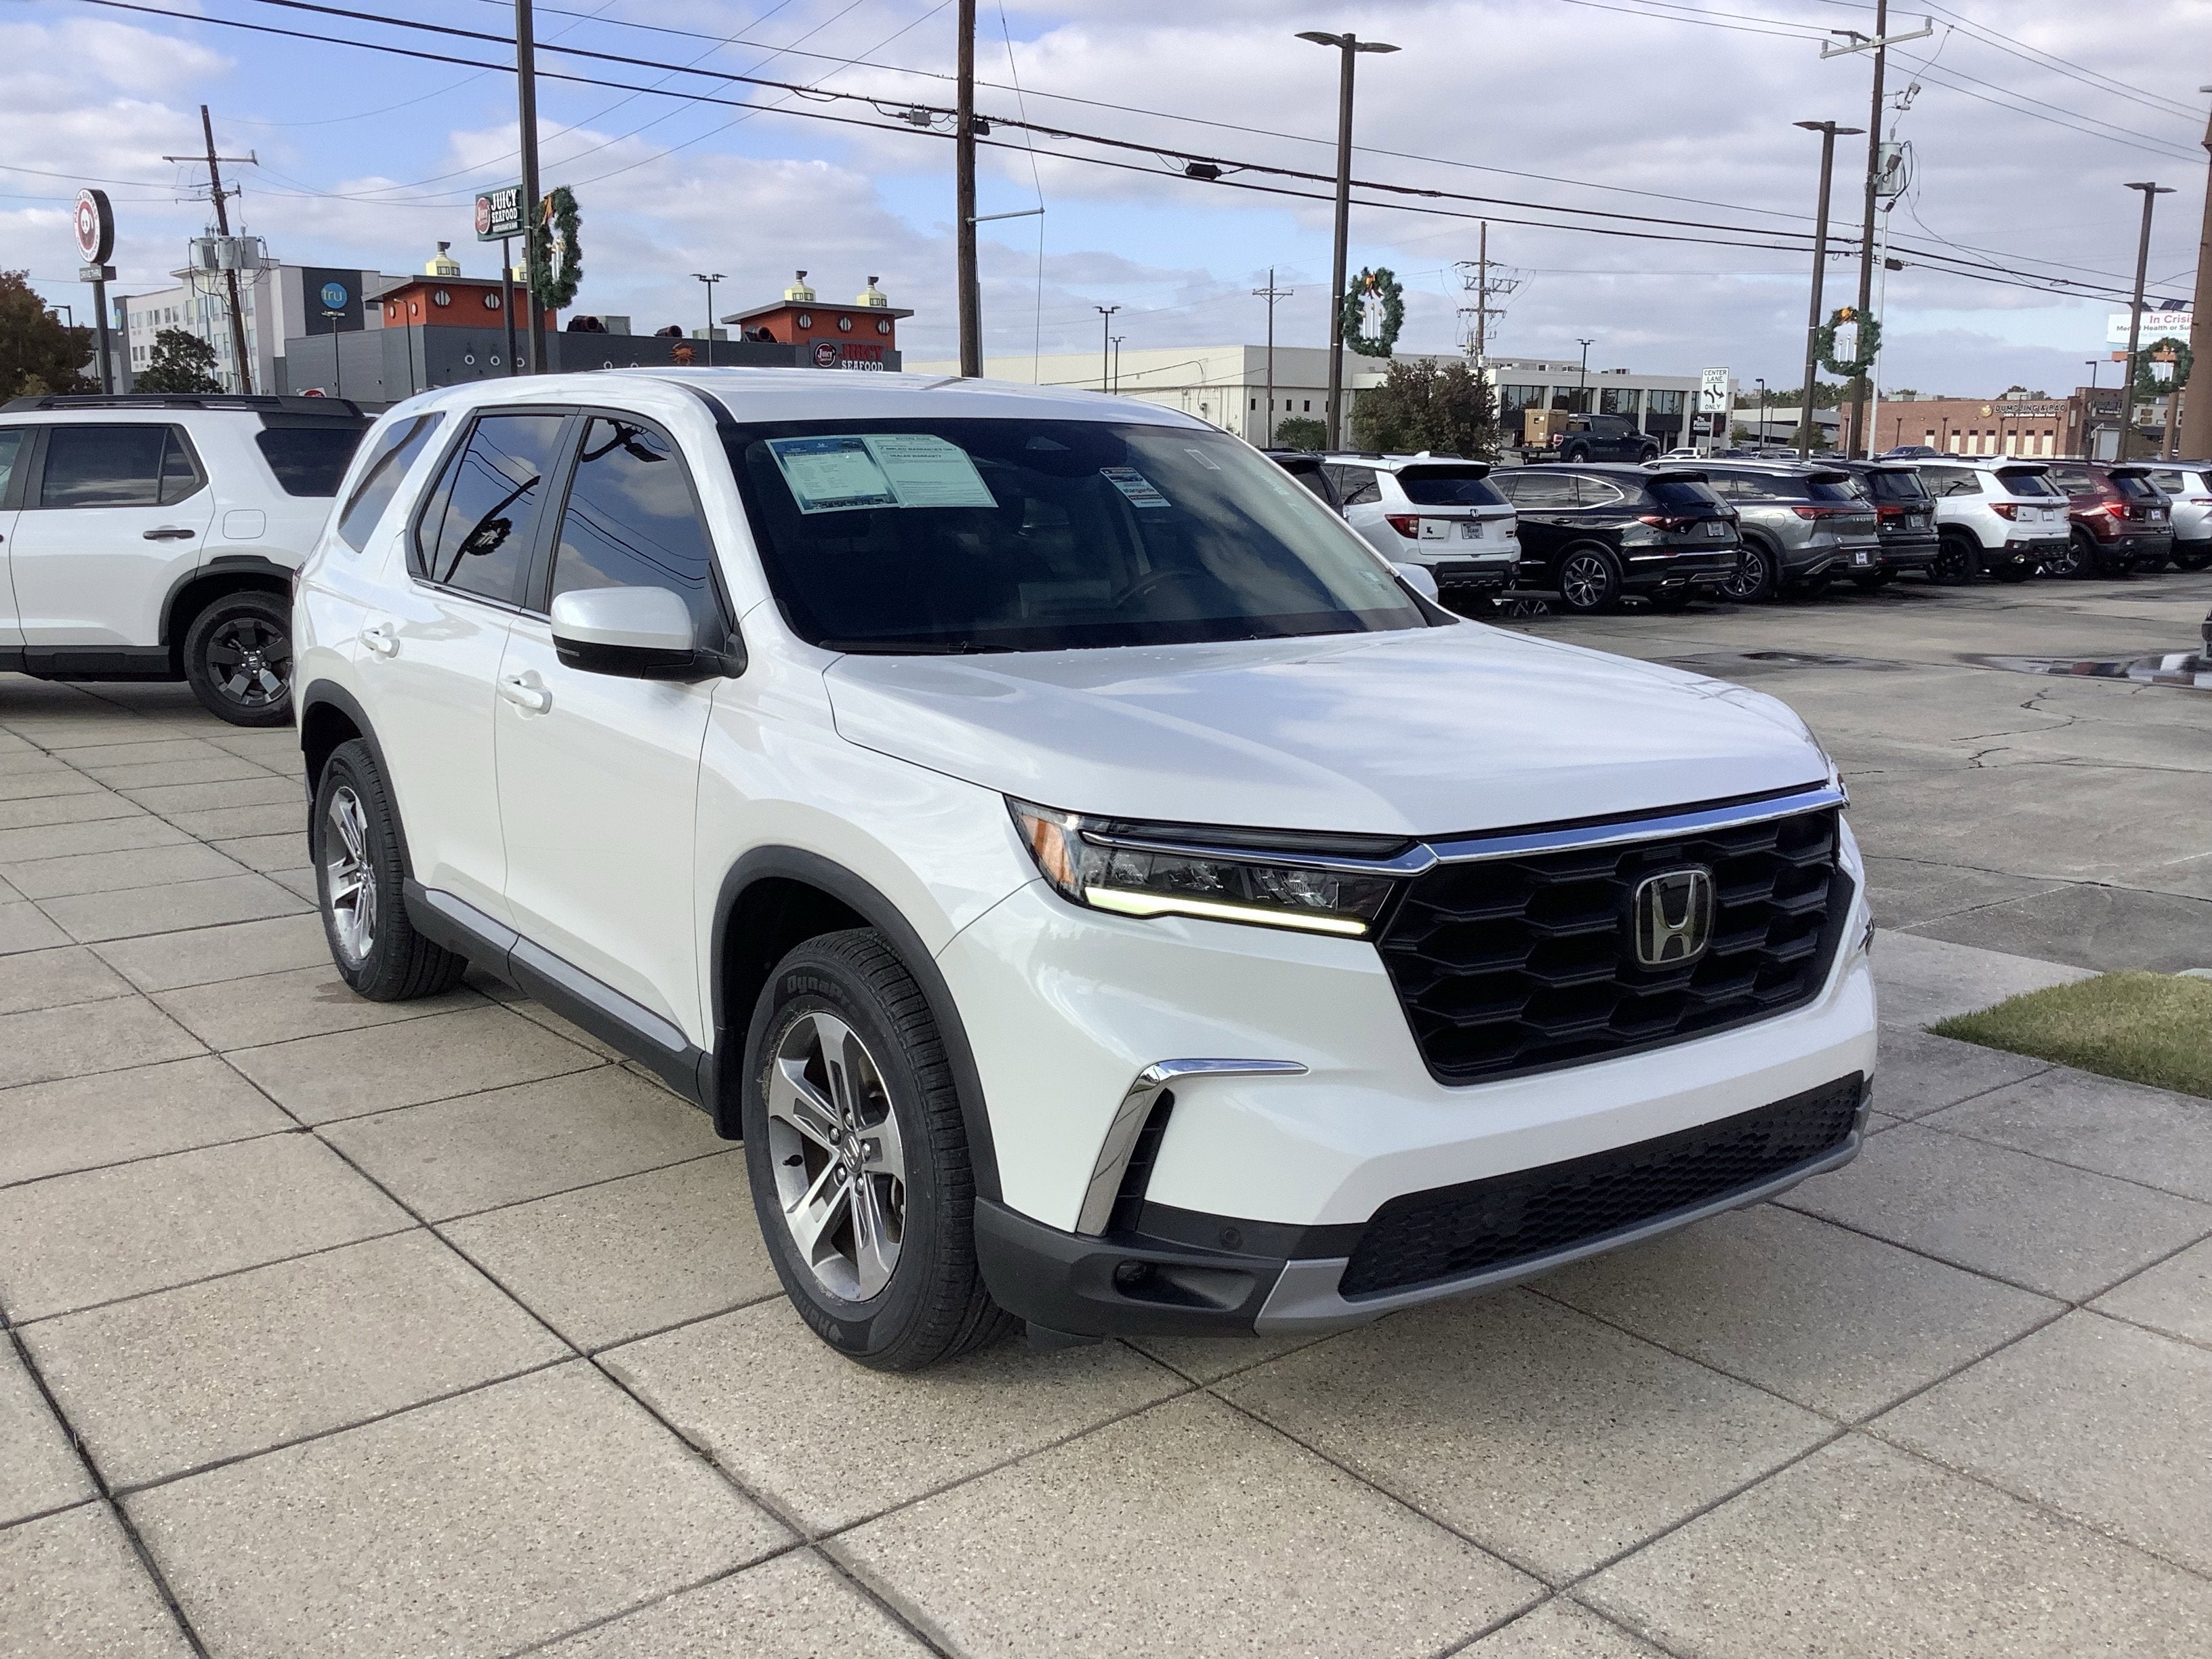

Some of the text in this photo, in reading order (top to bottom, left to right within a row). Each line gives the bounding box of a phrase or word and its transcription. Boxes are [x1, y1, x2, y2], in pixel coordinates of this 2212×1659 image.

[491, 189, 516, 211] JUICY
[491, 207, 518, 223] SEAFOOD
[321, 288, 342, 302] tru
[2150, 315, 2160, 323] In
[838, 344, 884, 361] JUICY
[841, 360, 884, 371] SEAFOOD
